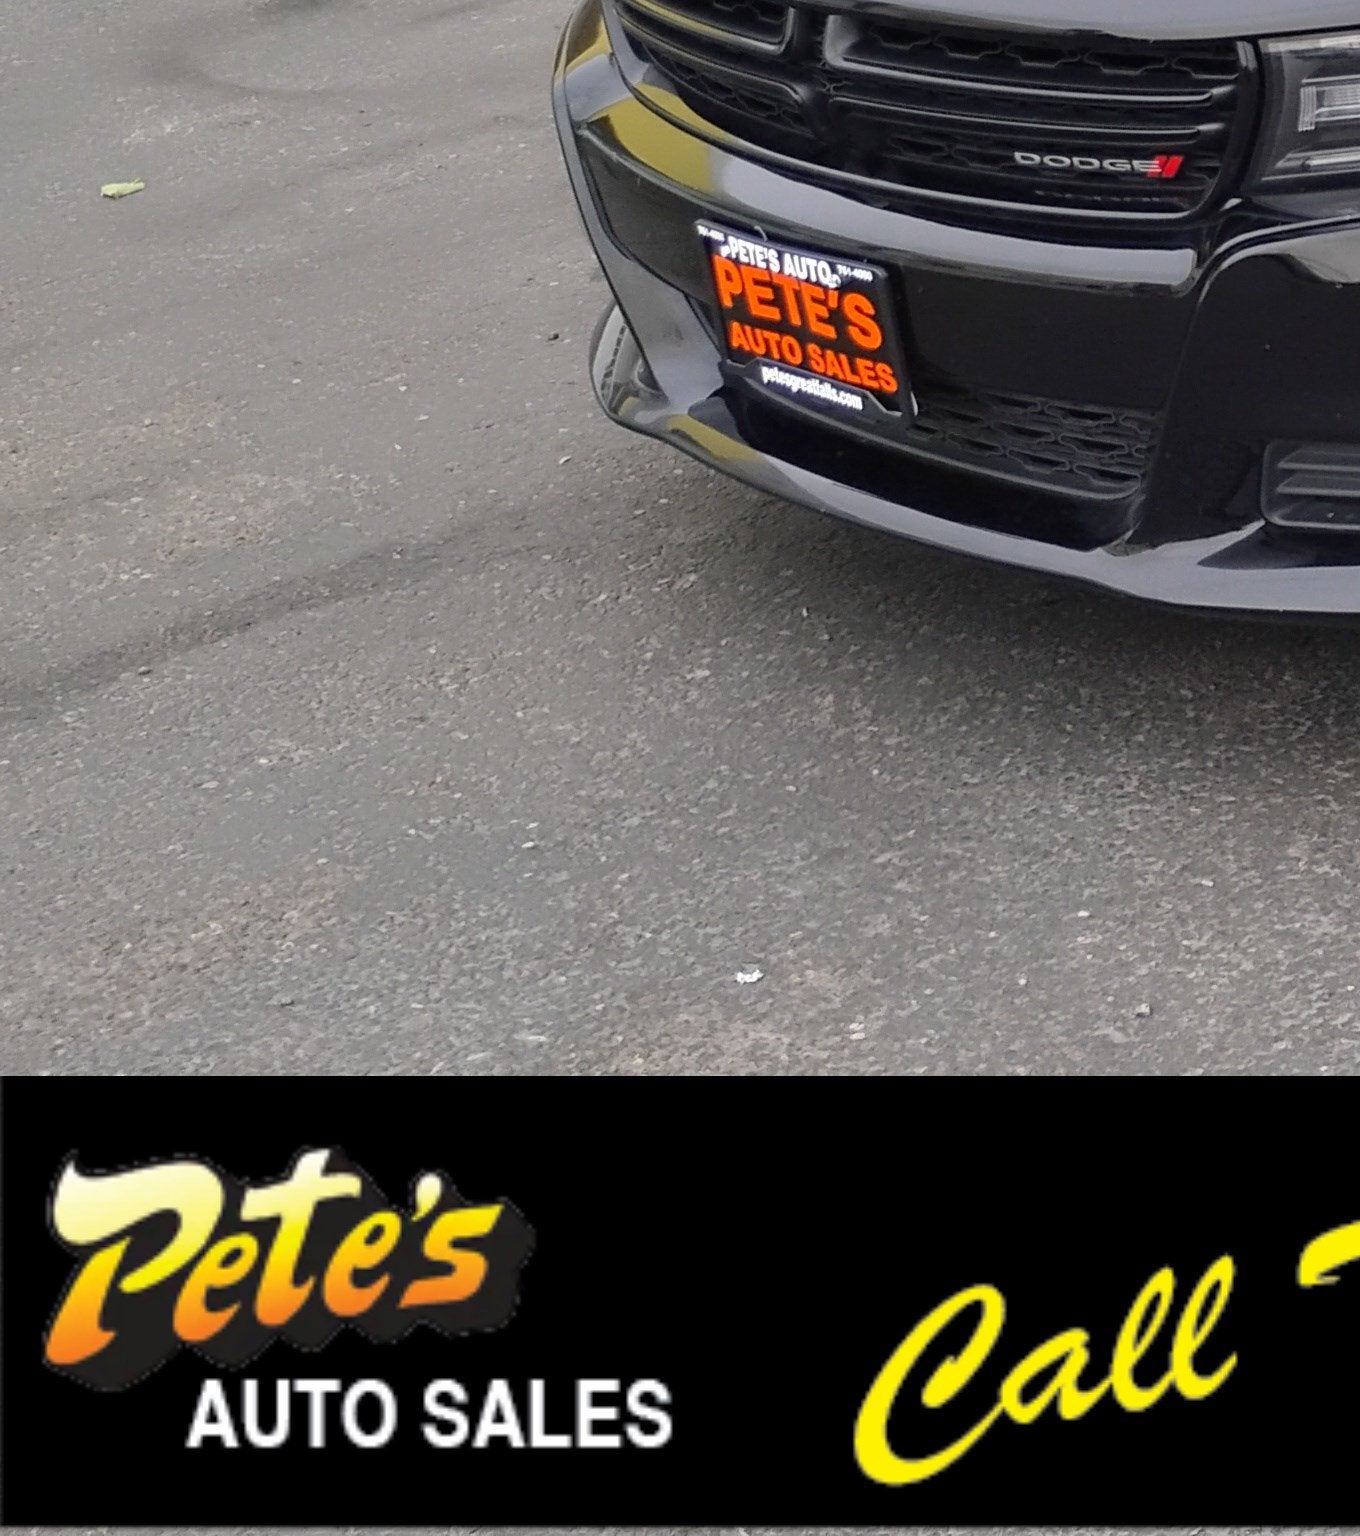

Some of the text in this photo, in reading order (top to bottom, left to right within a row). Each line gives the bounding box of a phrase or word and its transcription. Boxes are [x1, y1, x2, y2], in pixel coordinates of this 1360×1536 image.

[1014, 151, 1162, 173] DODGE
[726, 235, 832, 287] PETE'S AUTO
[712, 253, 883, 351] PETE'S
[730, 321, 898, 395] AUTO SALES
